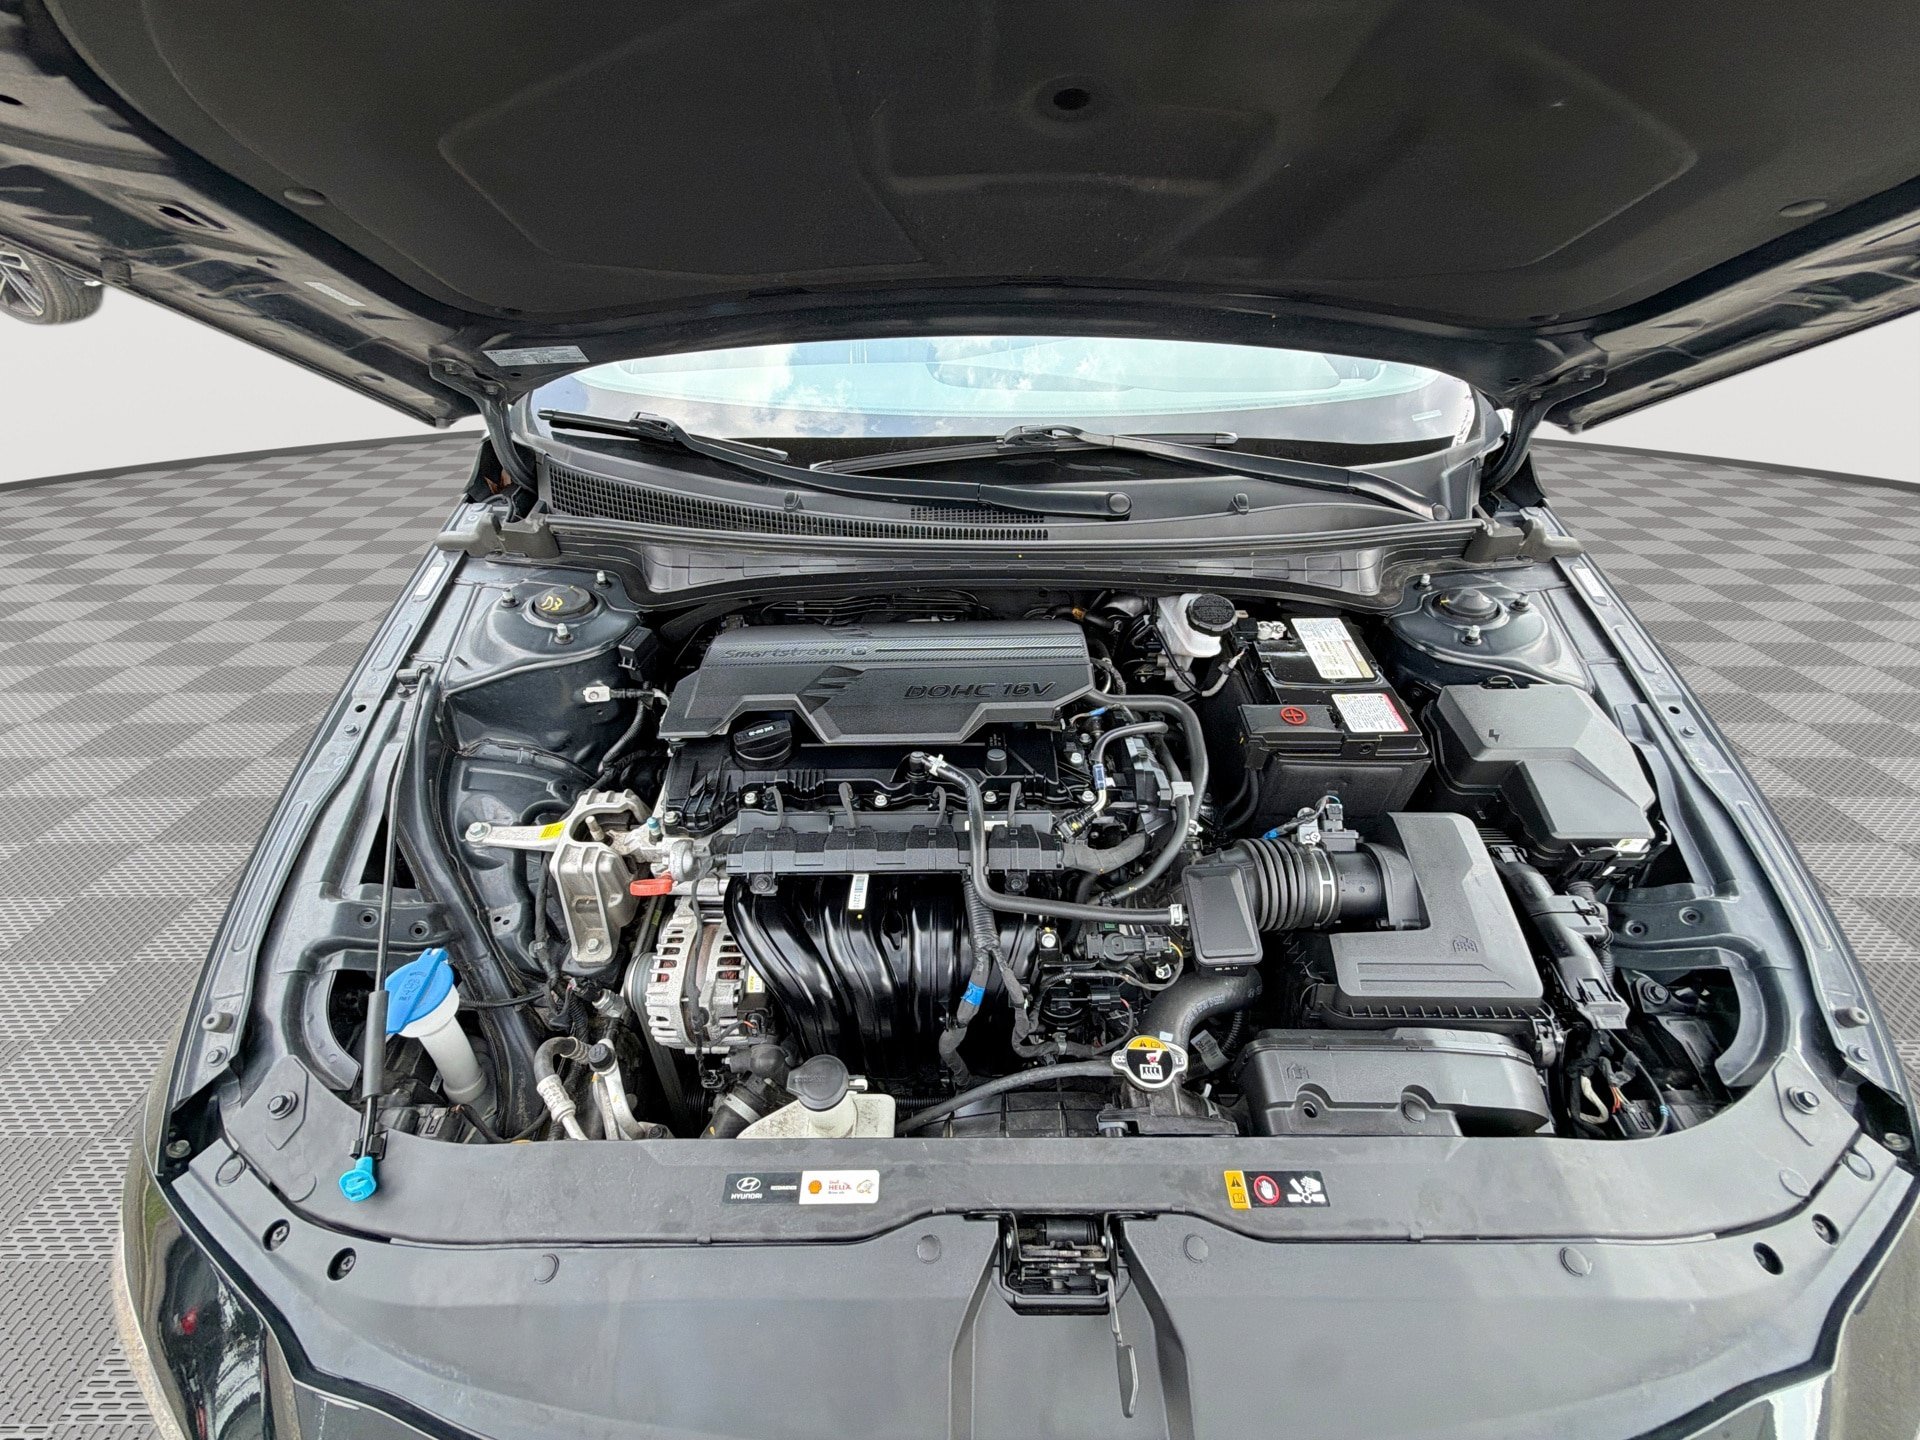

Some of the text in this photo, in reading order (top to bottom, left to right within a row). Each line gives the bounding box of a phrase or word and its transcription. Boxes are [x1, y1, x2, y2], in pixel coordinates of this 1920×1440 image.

[720, 648, 848, 659] Smartstream
[903, 682, 1057, 699] DOHC 16V
[828, 1182, 851, 1191] HELIX
